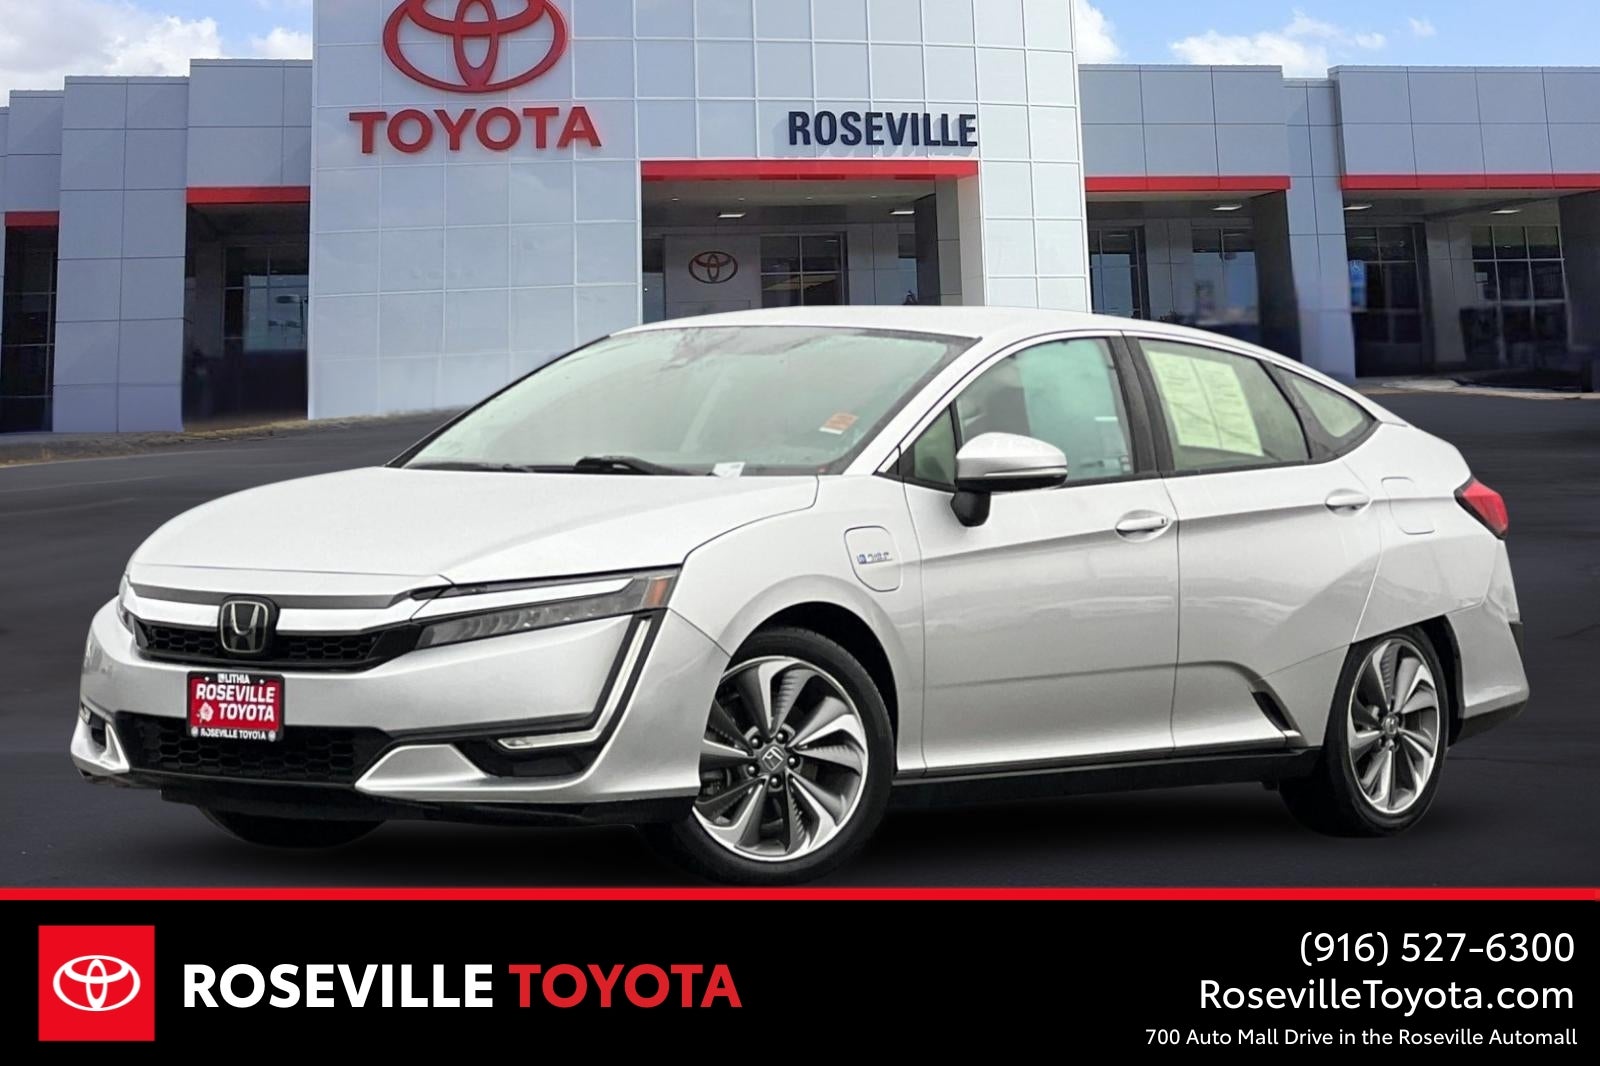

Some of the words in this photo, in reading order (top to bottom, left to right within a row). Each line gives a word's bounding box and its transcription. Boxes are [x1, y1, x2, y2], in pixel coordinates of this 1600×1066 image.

[350, 106, 602, 154] TOYOTA
[788, 110, 978, 148] ROSEVILLE
[196, 683, 276, 703] ROSEVILLE
[218, 703, 275, 722] TOYOTA
[200, 728, 238, 739] ROSEVILLE
[239, 730, 267, 740] TOYOTA
